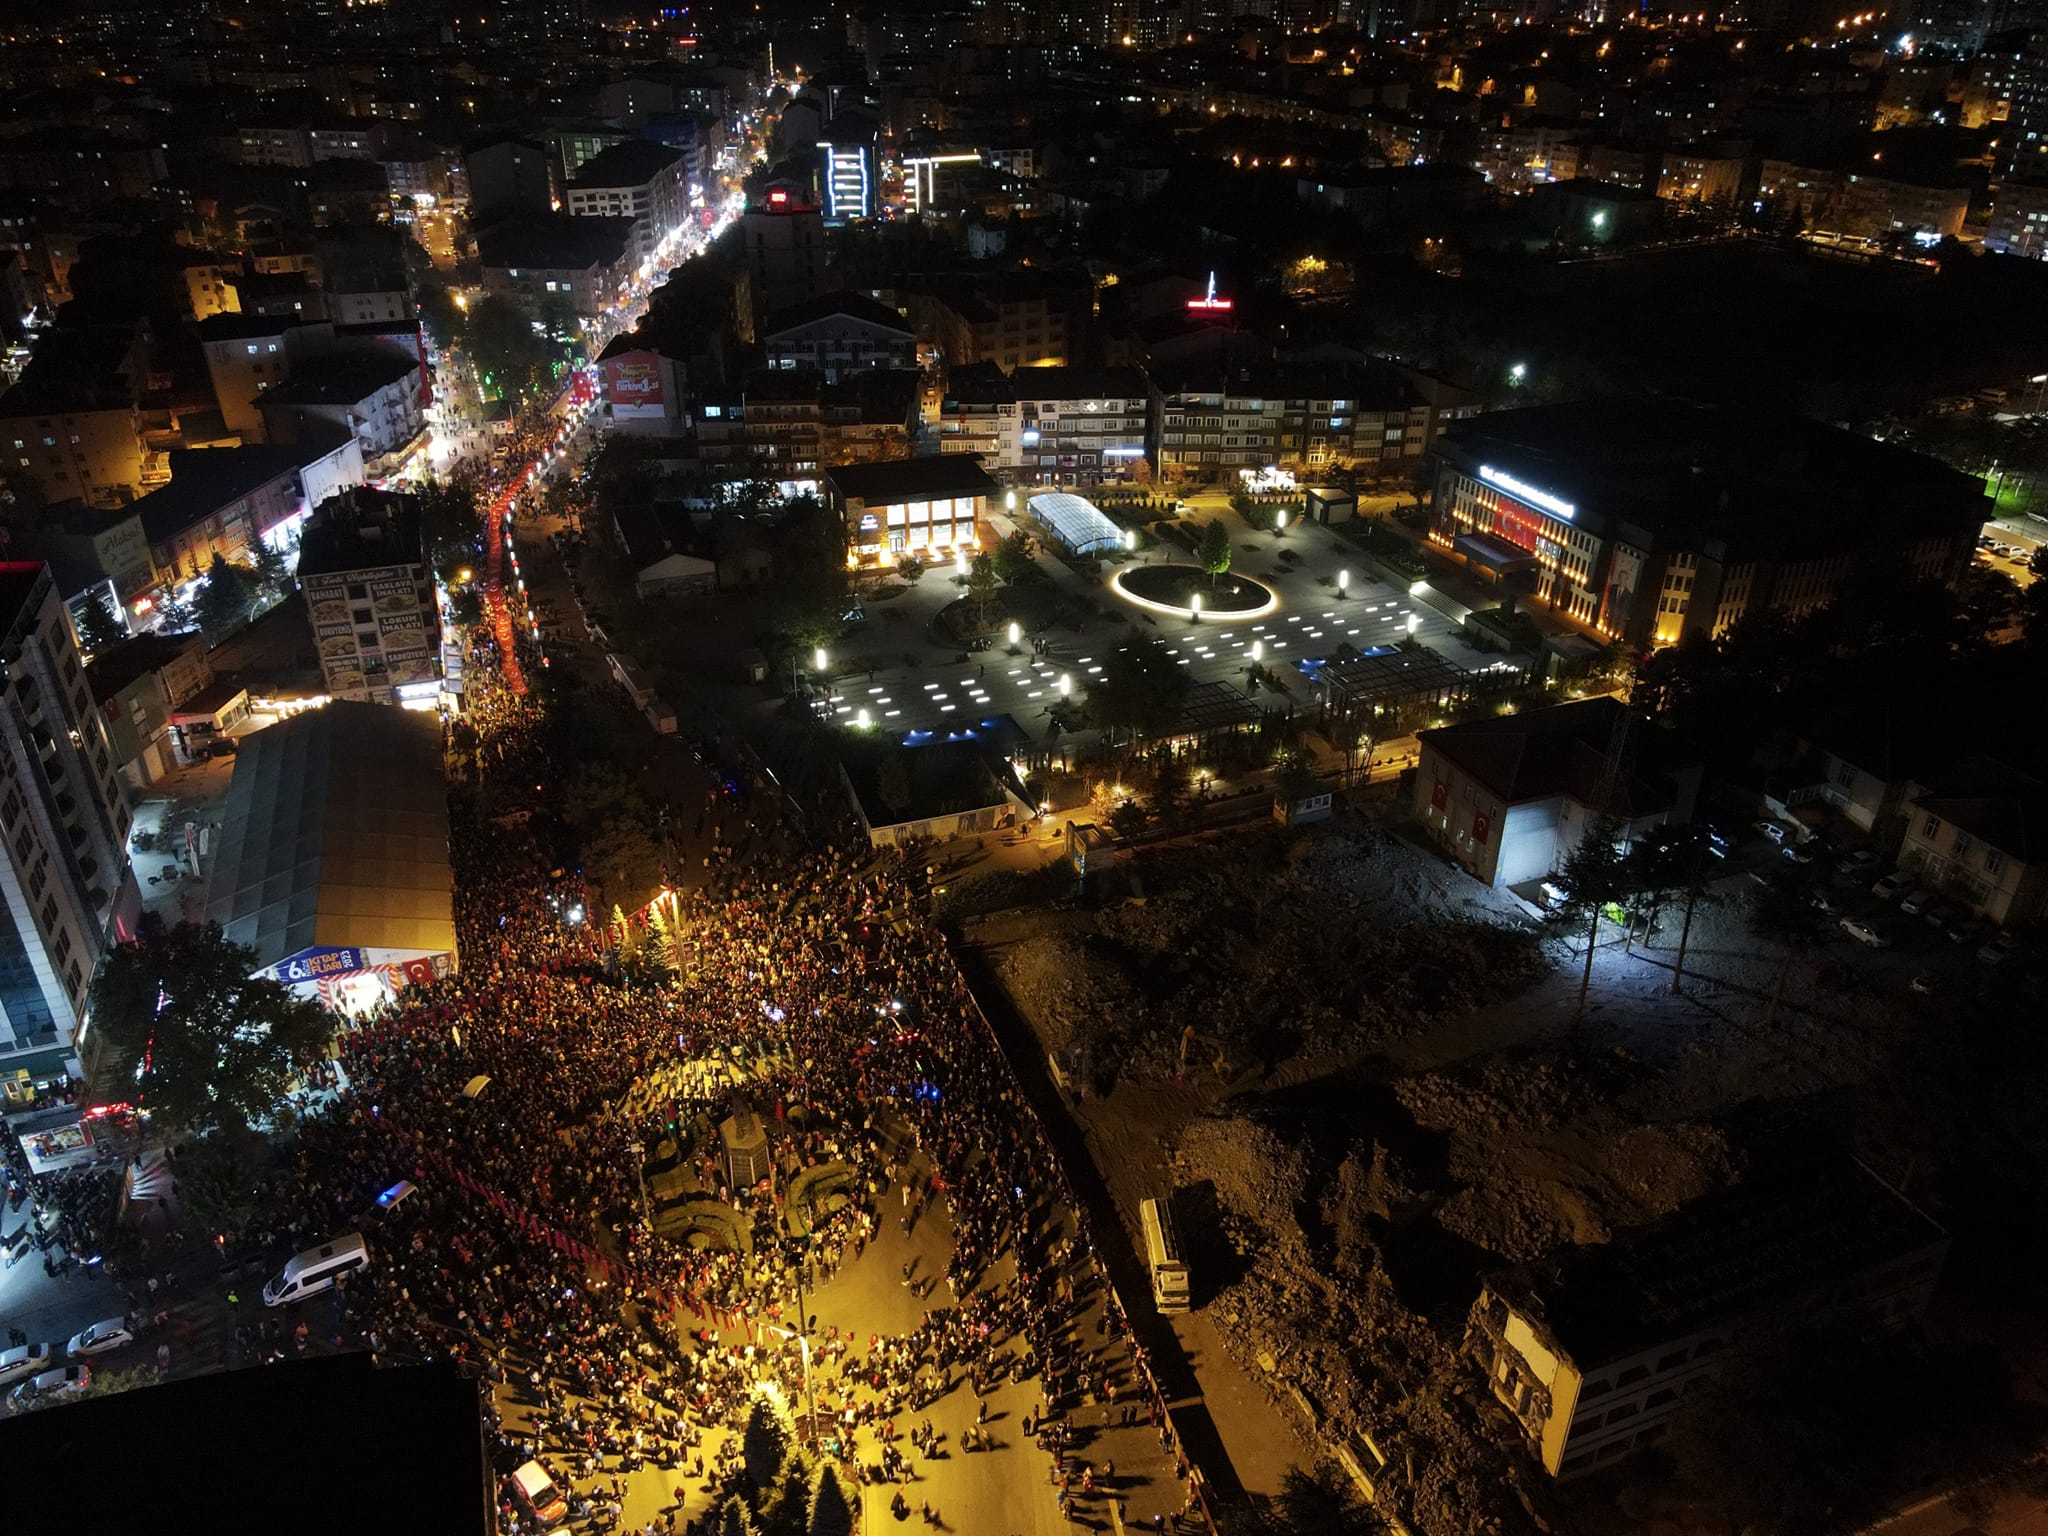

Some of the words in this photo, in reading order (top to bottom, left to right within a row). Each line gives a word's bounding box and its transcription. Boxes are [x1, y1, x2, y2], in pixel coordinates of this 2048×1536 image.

[372, 580, 413, 590] BAKLAVA
[310, 589, 343, 601] BAHARAT
[376, 587, 412, 598] İMALATI
[383, 615, 417, 625] LOKUM
[382, 622, 421, 633] İMALATI
[340, 950, 353, 968] 2023
[311, 962, 343, 975] FUARI
